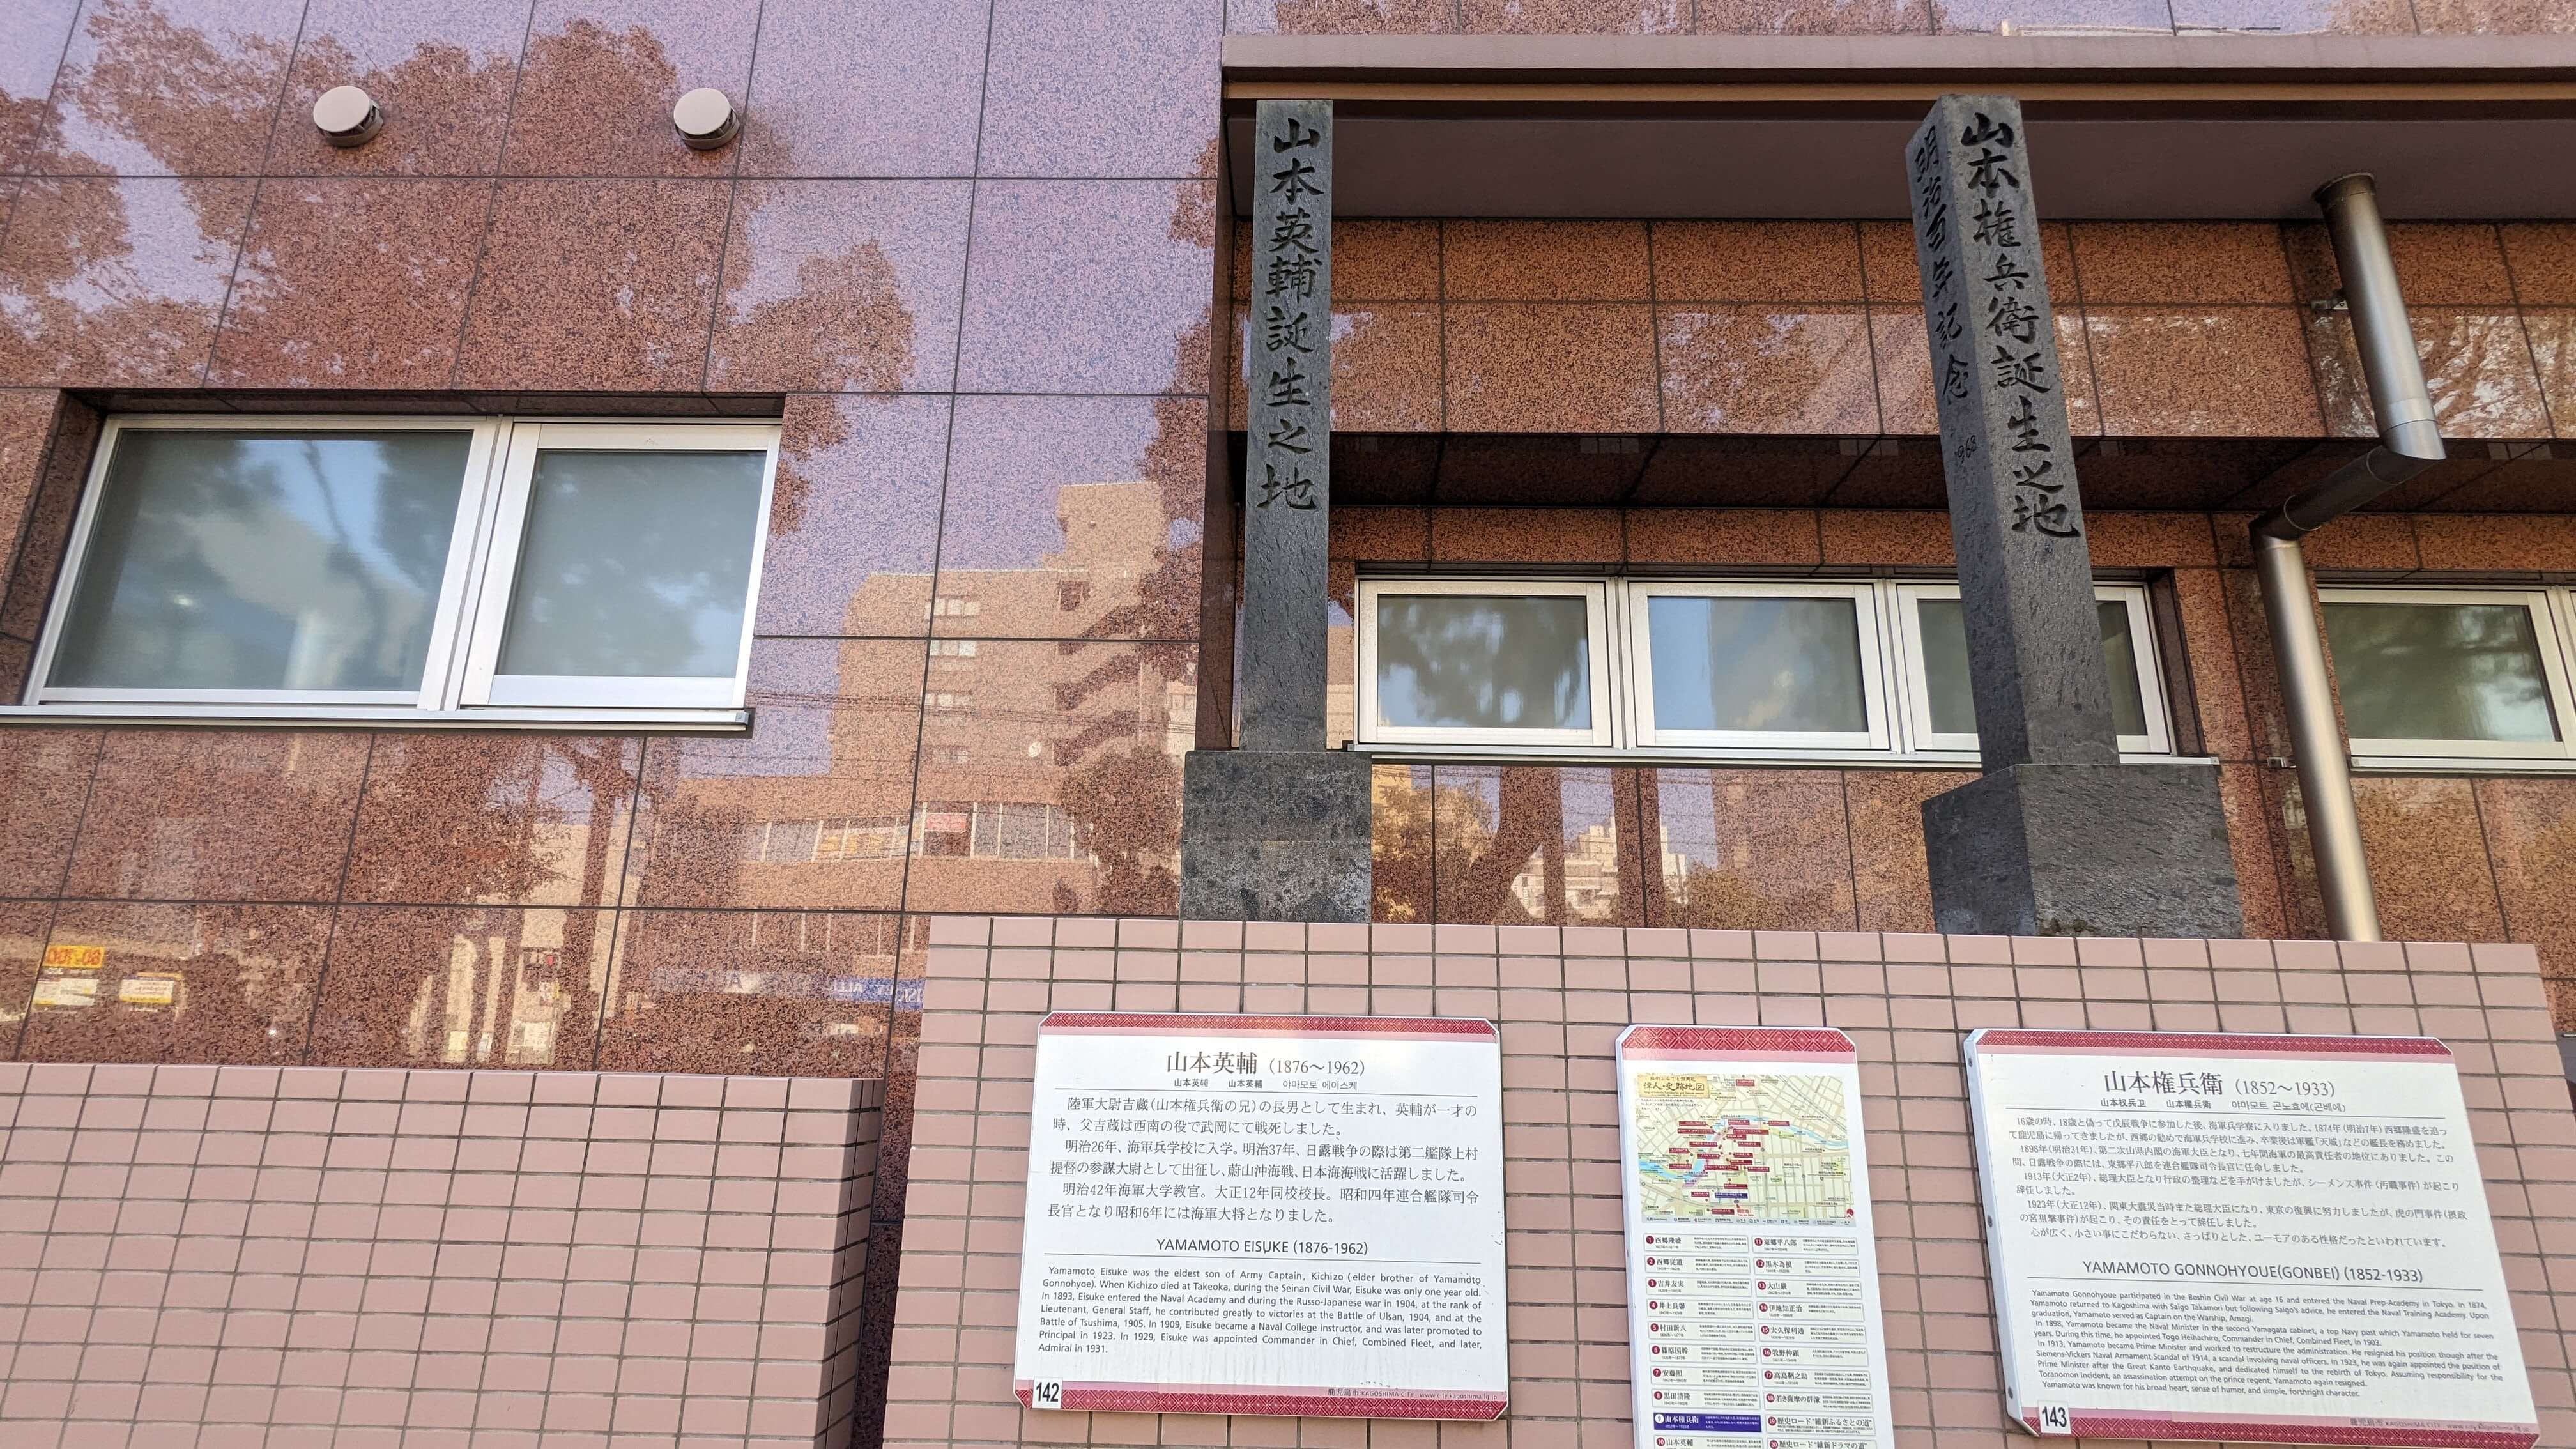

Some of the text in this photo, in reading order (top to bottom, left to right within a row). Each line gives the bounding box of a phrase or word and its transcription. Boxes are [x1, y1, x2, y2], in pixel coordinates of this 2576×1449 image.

[1257, 118, 1324, 512] 山本英輔誕生之地
[1961, 112, 2082, 538] 山本権兵衛誕生之地
[1167, 1050, 1258, 1075] 山本英輔
[1228, 1078, 1263, 1089] 山本英輔
[1282, 1080, 1318, 1089] 야마모토
[1322, 1080, 1358, 1091] 에이스케
[2104, 1070, 2223, 1096] 山本権兵衛
[2231, 1100, 2269, 1110] 야마모토
[1062, 1182, 1479, 1205] 明治42年海軍大学教官。大正12年同校校長。昭和四年連合艦隊司令
[1156, 1238, 1368, 1256] YAMAMOTO EISUKE (1876-1962)
[1048, 1266, 1096, 1276] Yamamoto
[1100, 1267, 1128, 1276] Eisuke
[1154, 1268, 1169, 1277] the
[1174, 1268, 1200, 1278] eldest
[1225, 1269, 1236, 1278] of
[1239, 1270, 1264, 1282] Army
[1268, 1271, 1306, 1282] Captain,
[1311, 1271, 1344, 1281] Kichizo
[1380, 1273, 1414, 1283] brother
[1418, 1273, 1429, 1283] of
[1433, 1274, 1482, 1284] Yamamoto
[2082, 1261, 2423, 1284] YAMAMOTO GONNOHYOUE(GONBEI) (1852-1933)
[1042, 1278, 1097, 1290] Gonnohyoe).
[1099, 1279, 1124, 1289] When
[1127, 1280, 1158, 1289] Kichizo
[1160, 1280, 1179, 1290] died
[1181, 1282, 1191, 1291] at
[1193, 1282, 1231, 1292] Takeoka,
[1233, 1282, 1262, 1294] during
[1264, 1283, 1280, 1292] the
[1281, 1283, 1310, 1293] Seinan
[1312, 1284, 1330, 1294] Civil
[1333, 1285, 1353, 1296] War,
[1355, 1285, 1383, 1295] Eisuke
[1404, 1286, 1422, 1298] only
[1443, 1289, 1462, 1298] year
[1464, 1287, 1481, 1298] old.
[1041, 1291, 1050, 1300] In
[1053, 1291, 1075, 1302] 1893,
[1078, 1292, 1105, 1301] Eisuke
[1107, 1292, 1141, 1302] entered
[1143, 1293, 1158, 1303] the
[1160, 1294, 1184, 1303] Naval
[1186, 1294, 1227, 1307] Academy
[1229, 1295, 1245, 1304] and
[1248, 1295, 1276, 1307] during
[1278, 1296, 1294, 1306] the
[1296, 1297, 1362, 1309] Russo-Japanese
[1384, 1298, 1392, 1308] in
[1395, 1300, 1418, 1310] 1904,
[1420, 1300, 1430, 1309] at
[1432, 1300, 1447, 1309] the
[1450, 1300, 1469, 1310] rank
[1471, 1301, 1482, 1310] of
[2032, 1289, 2070, 1298] Yamamoto
[2072, 1291, 2117, 1300] Gonnohyoue
[2119, 1292, 2161, 1301] participated
[2173, 1292, 2186, 1301] the
[2188, 1293, 2212, 1301] Boshin
[2369, 1298, 2419, 1309] Prep-Academy
[2432, 1300, 2455, 1309] Tokyo.
[2468, 1301, 2487, 1310] 1874,
[1041, 1304, 1482, 1323] Lieutenant, General Staff, he contributed greatly to victories at the Battle of Ulsan, 1904, and at the
[1036, 1382, 1059, 1402] 142
[2042, 1406, 2067, 1427] 143
